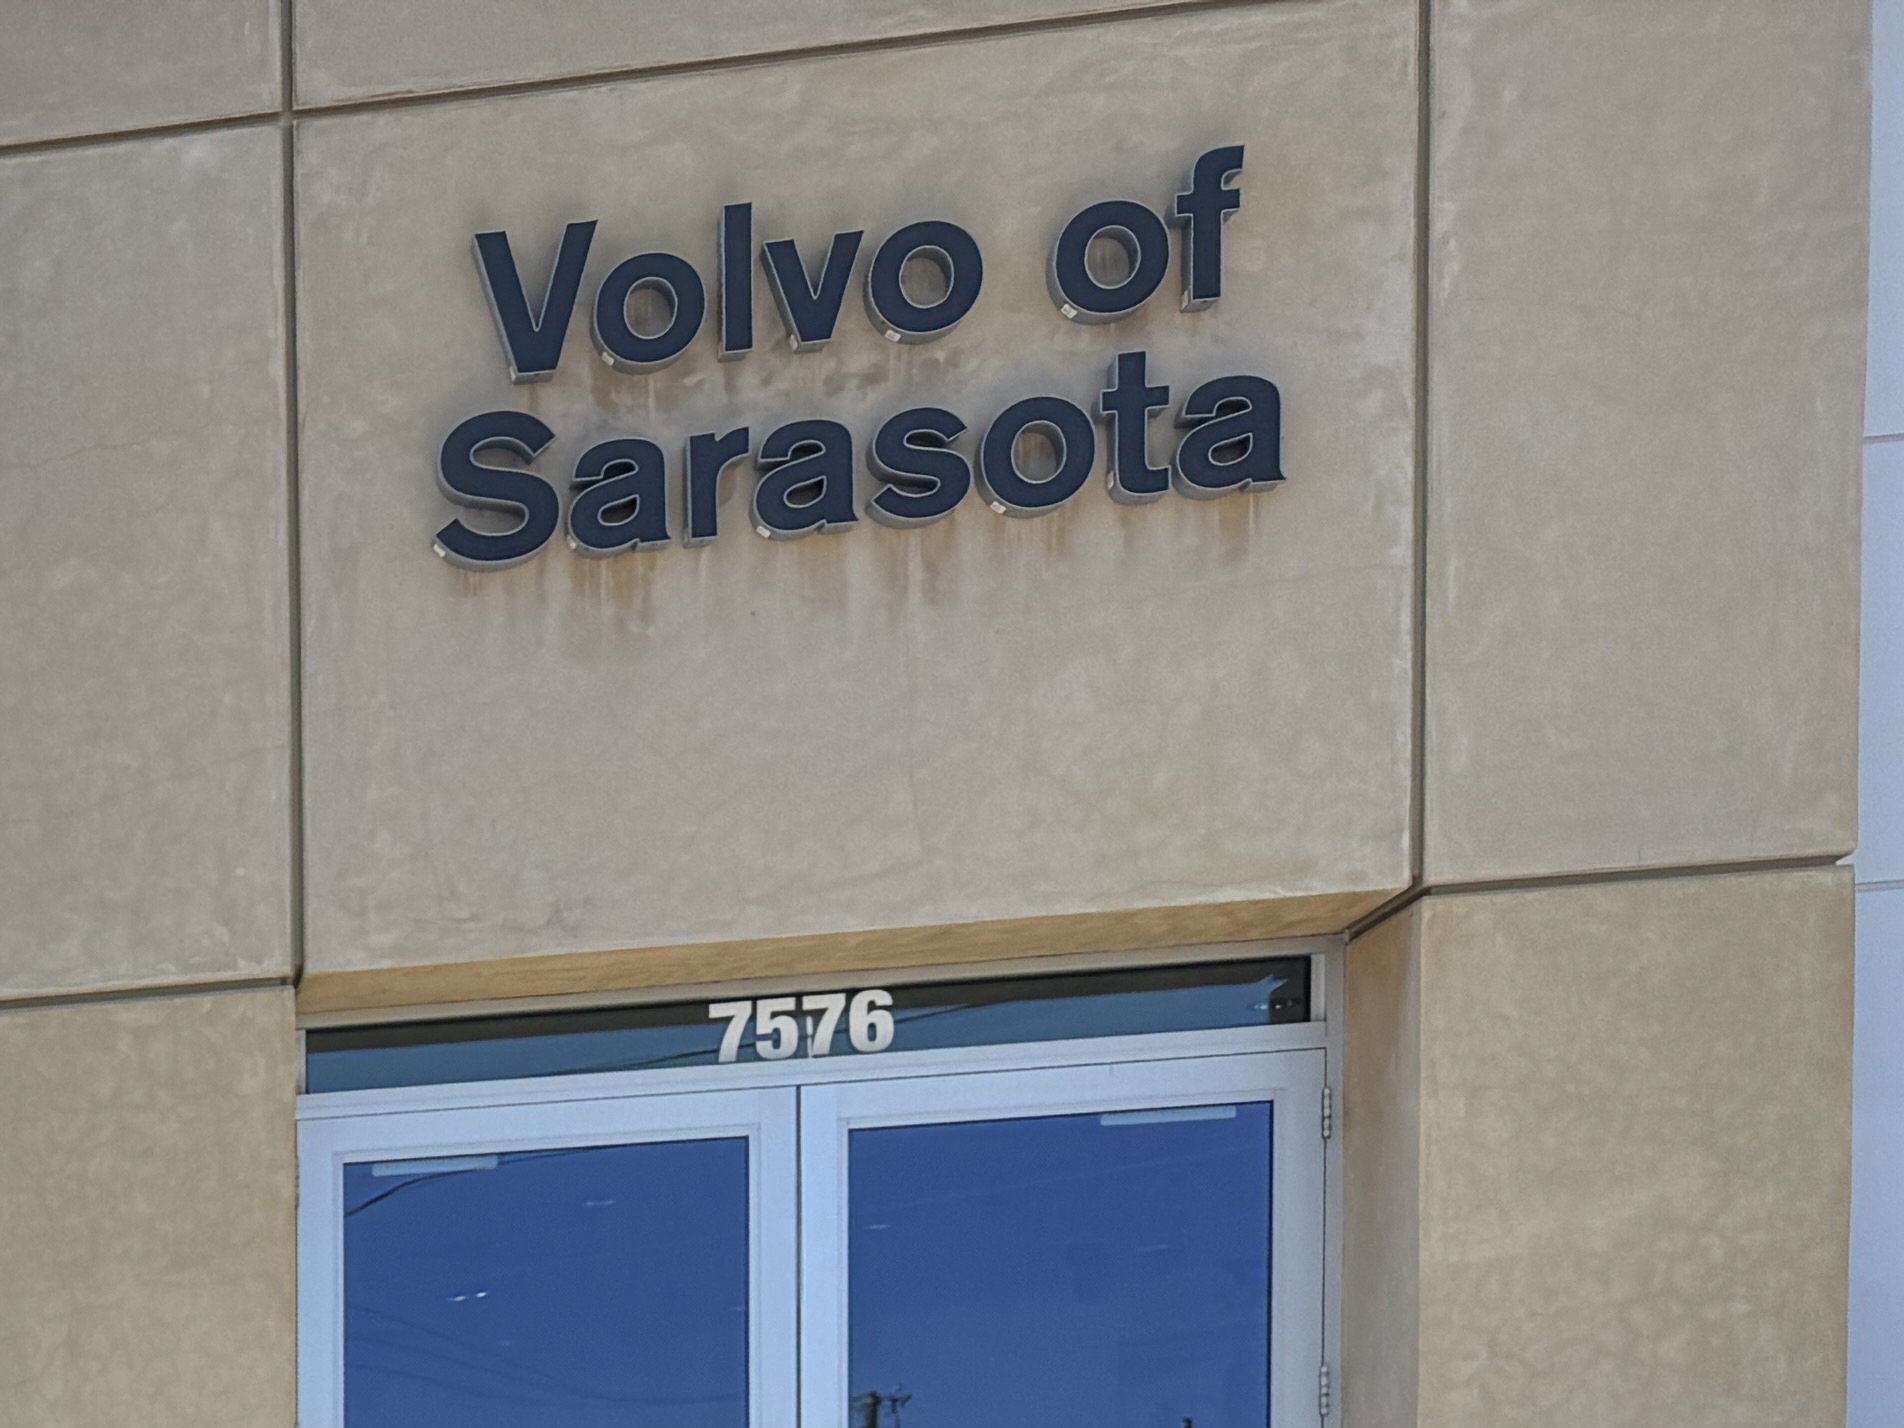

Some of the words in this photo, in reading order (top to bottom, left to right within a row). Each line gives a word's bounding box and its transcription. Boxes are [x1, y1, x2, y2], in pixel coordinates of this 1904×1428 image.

[472, 201, 985, 384] Volvo
[1045, 144, 1245, 323] of
[434, 350, 1288, 573] Sarasota
[708, 989, 895, 1064] 7576
